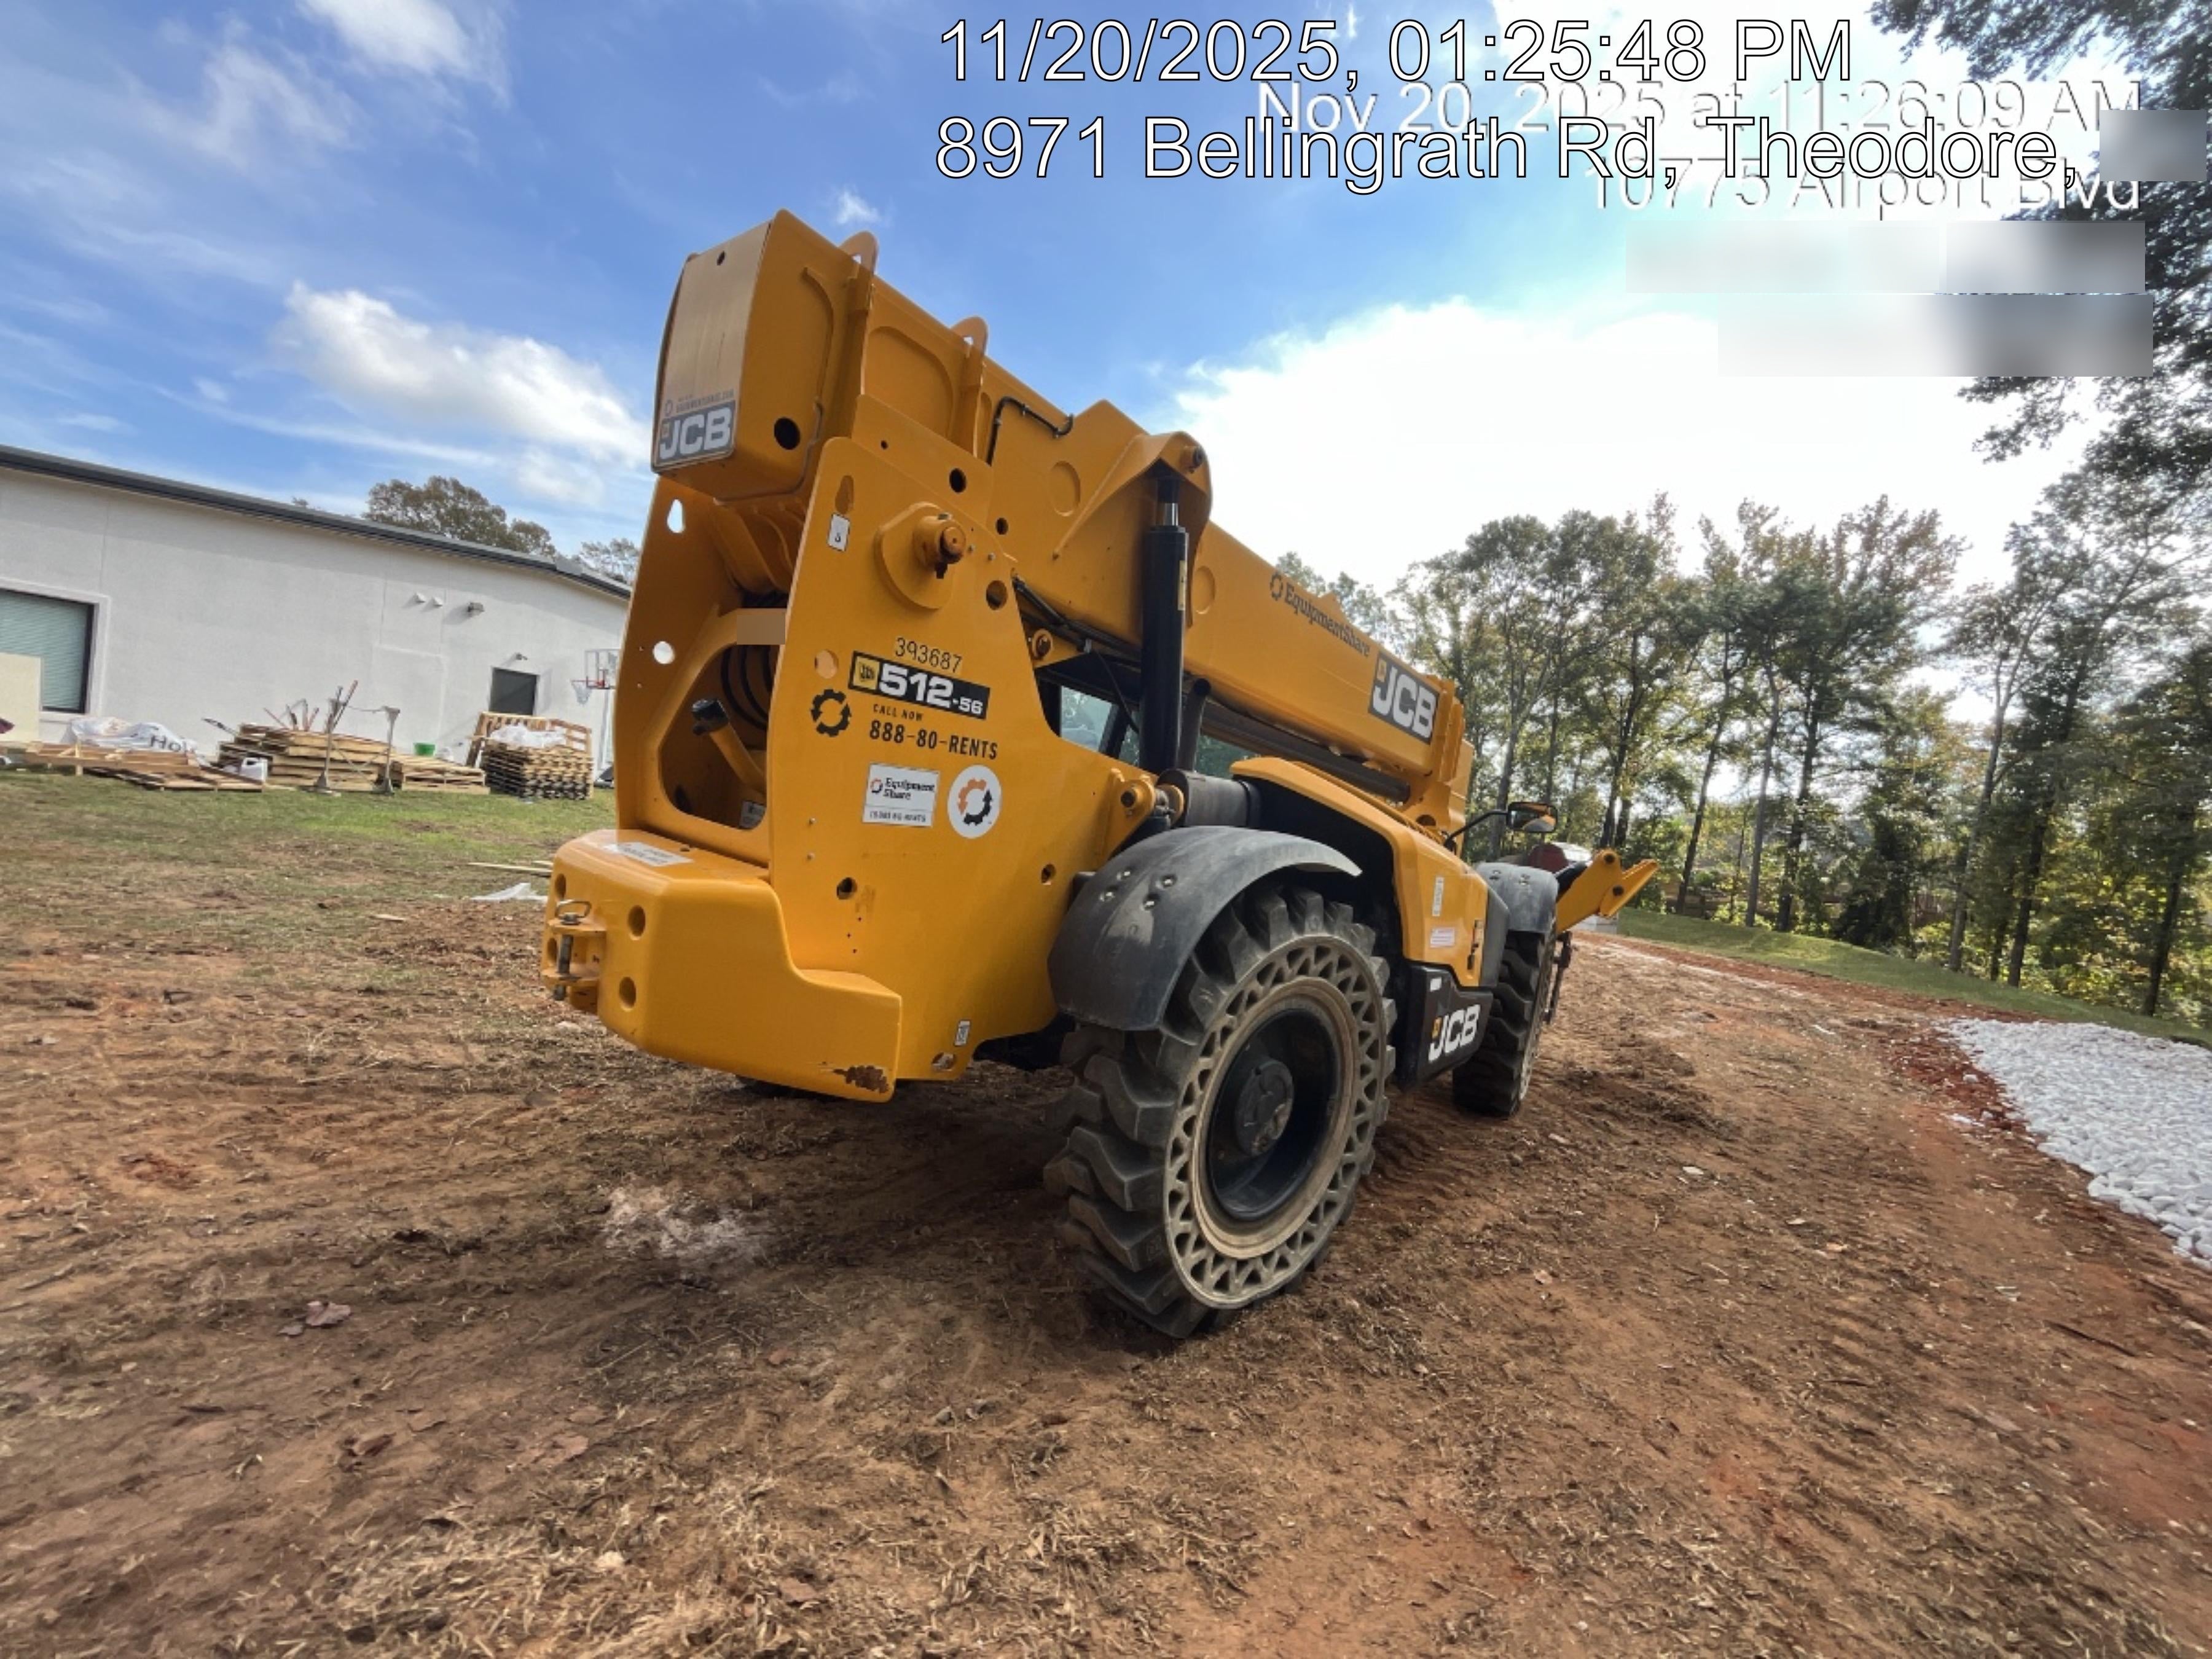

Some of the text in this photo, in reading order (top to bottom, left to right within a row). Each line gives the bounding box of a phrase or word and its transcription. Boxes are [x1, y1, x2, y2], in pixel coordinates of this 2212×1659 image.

[659, 407, 732, 460] JCB
[895, 637, 963, 673] 393687
[873, 704, 923, 721] CALL NOW
[1372, 666, 1437, 739] JCB
[869, 720, 998, 760] 888-80-RENTS
[1428, 1003, 1481, 1062] JCB
